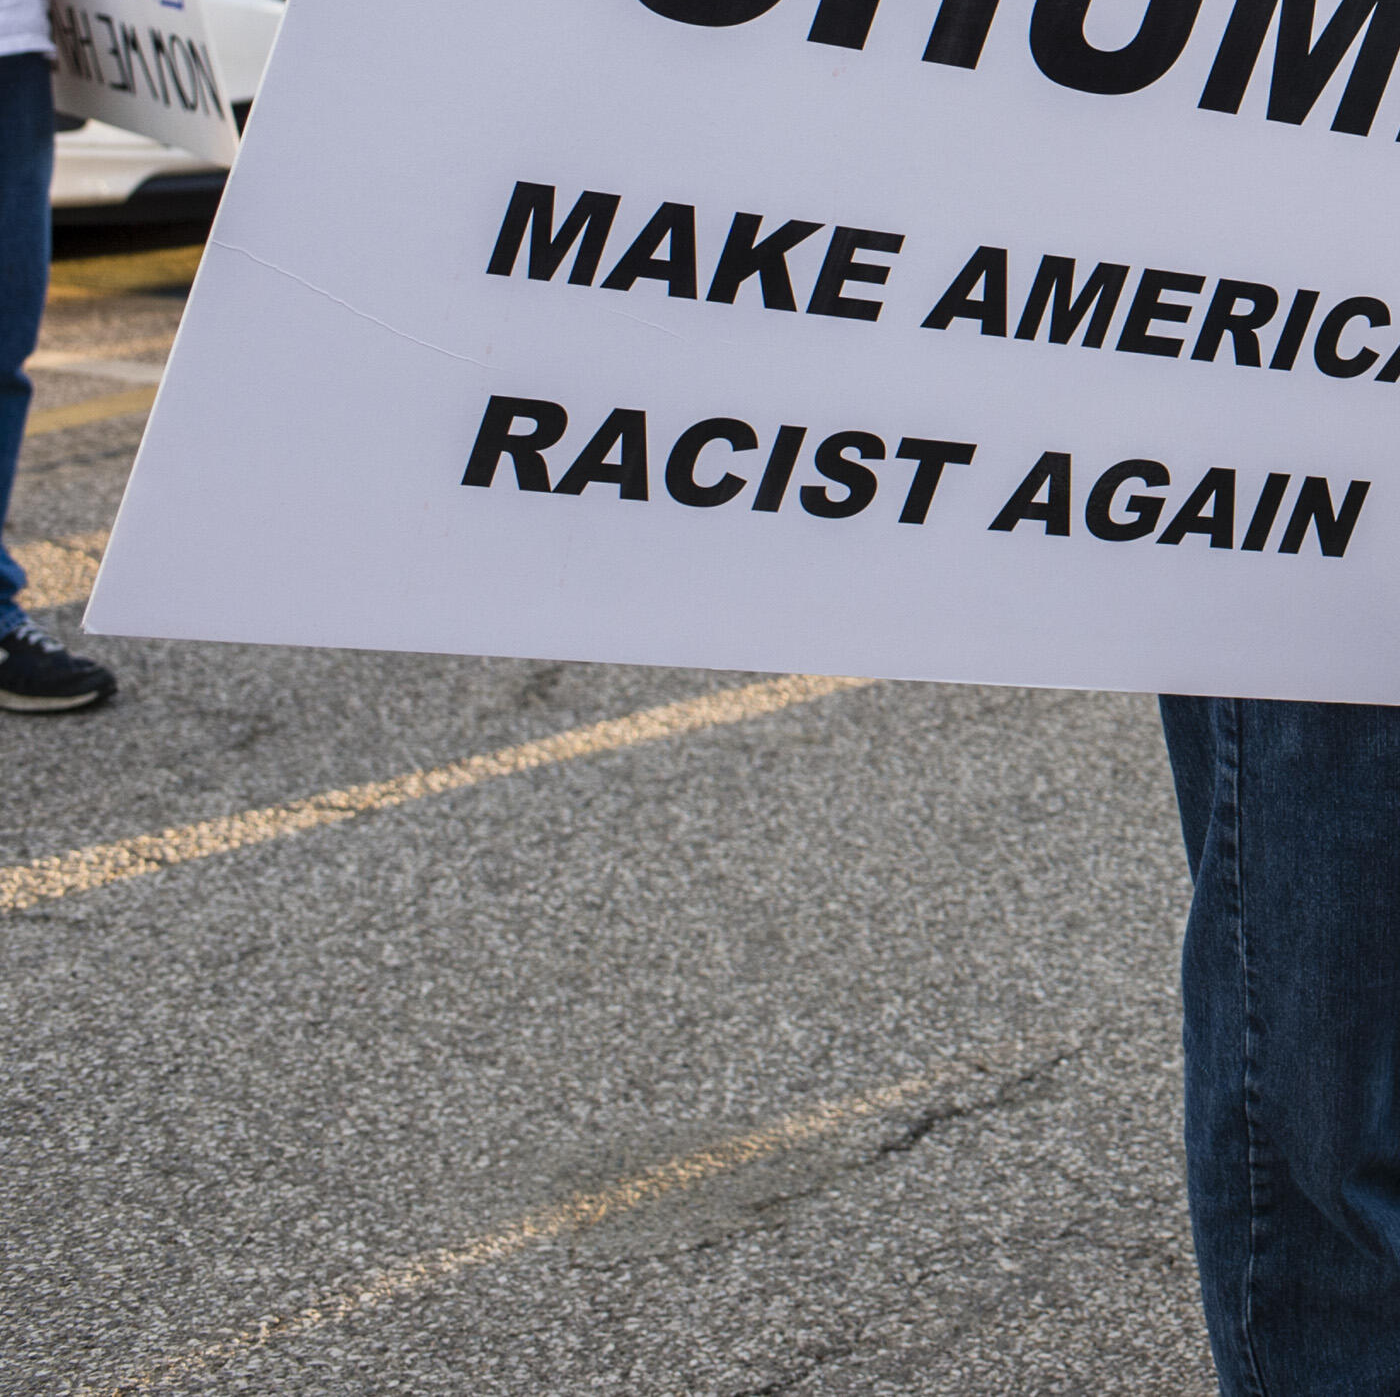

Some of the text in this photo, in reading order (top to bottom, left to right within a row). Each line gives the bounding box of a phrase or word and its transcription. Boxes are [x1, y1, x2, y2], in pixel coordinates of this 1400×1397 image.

[150, 24, 227, 123] NOW
[486, 180, 906, 322] MAKE
[460, 394, 1371, 558] RACIST AGAIN
